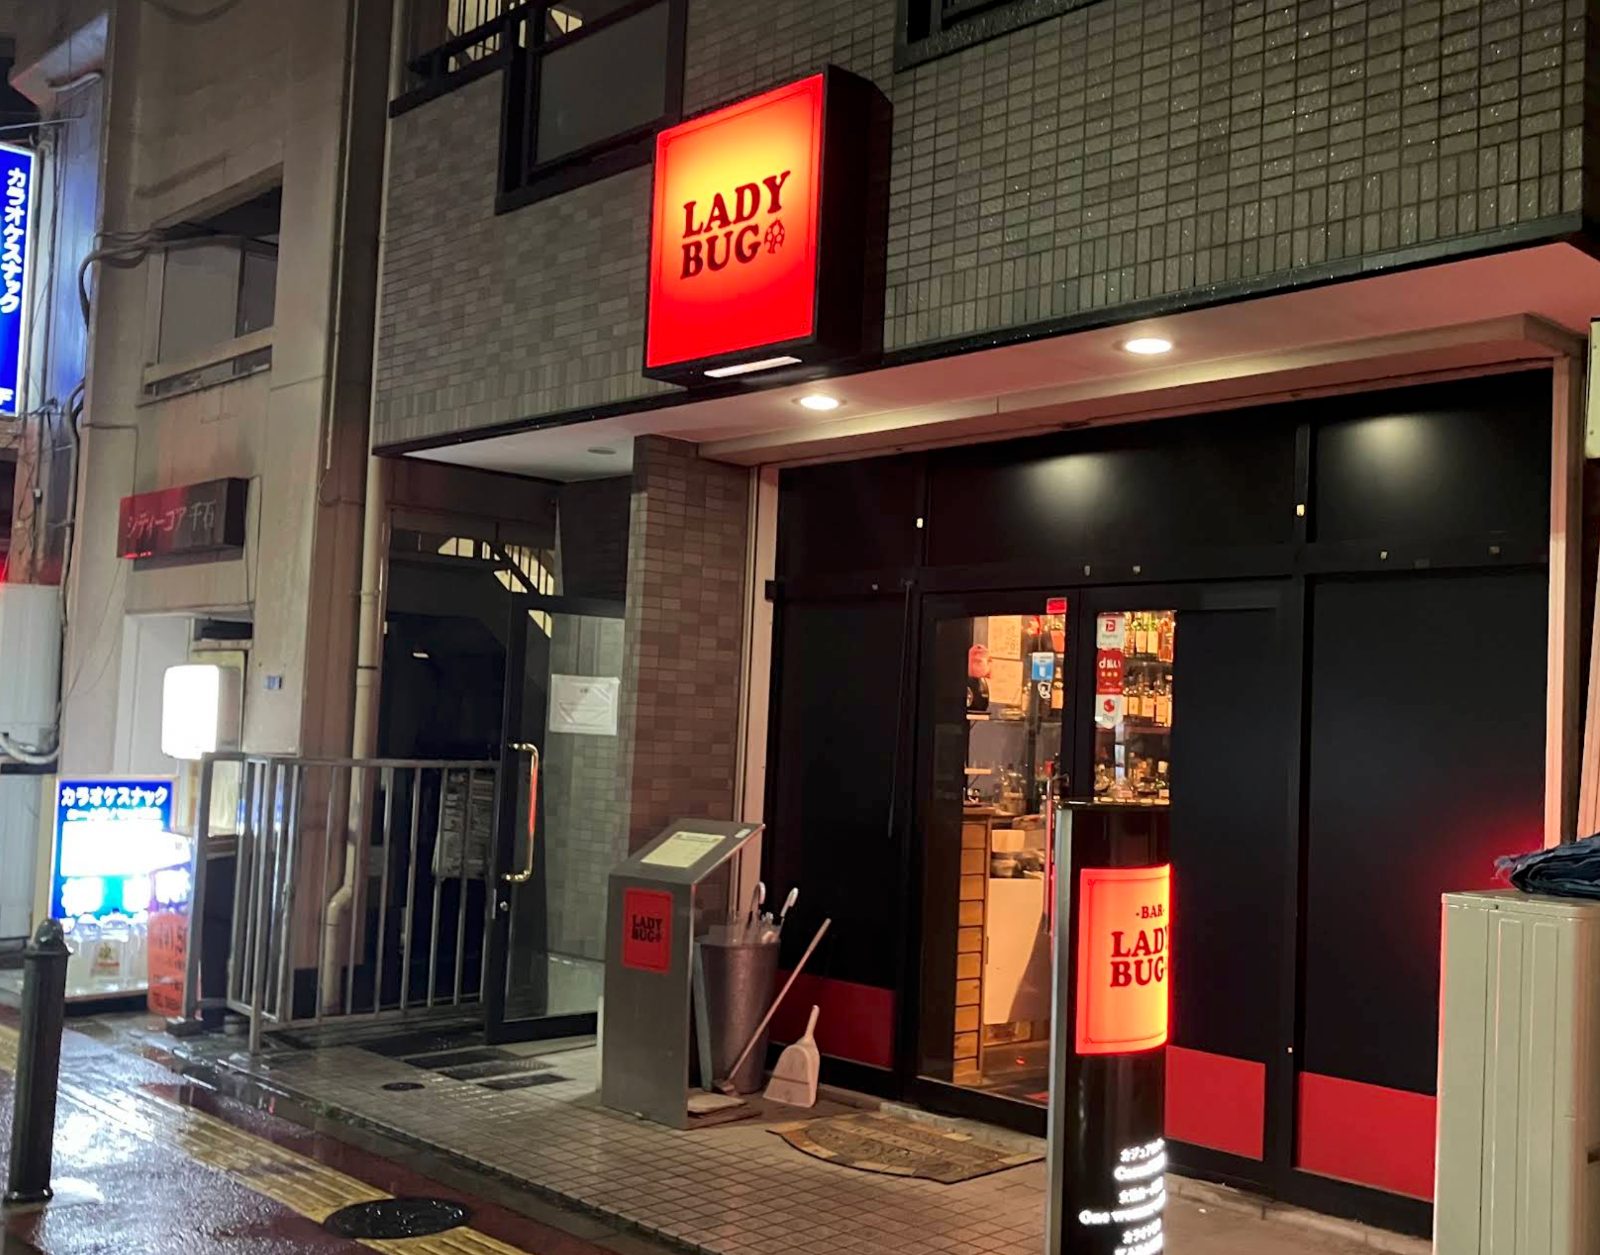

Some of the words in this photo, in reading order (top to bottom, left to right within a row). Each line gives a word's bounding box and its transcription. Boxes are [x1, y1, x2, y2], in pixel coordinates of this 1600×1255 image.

[682, 170, 791, 239] LADY
[0, 167, 26, 313] カラオケスナック
[680, 224, 762, 280] BUG
[61, 786, 168, 807] カラオケスナック
[631, 928, 656, 942] BUG
[632, 914, 663, 929] LADY
[1110, 957, 1165, 987] BUG
